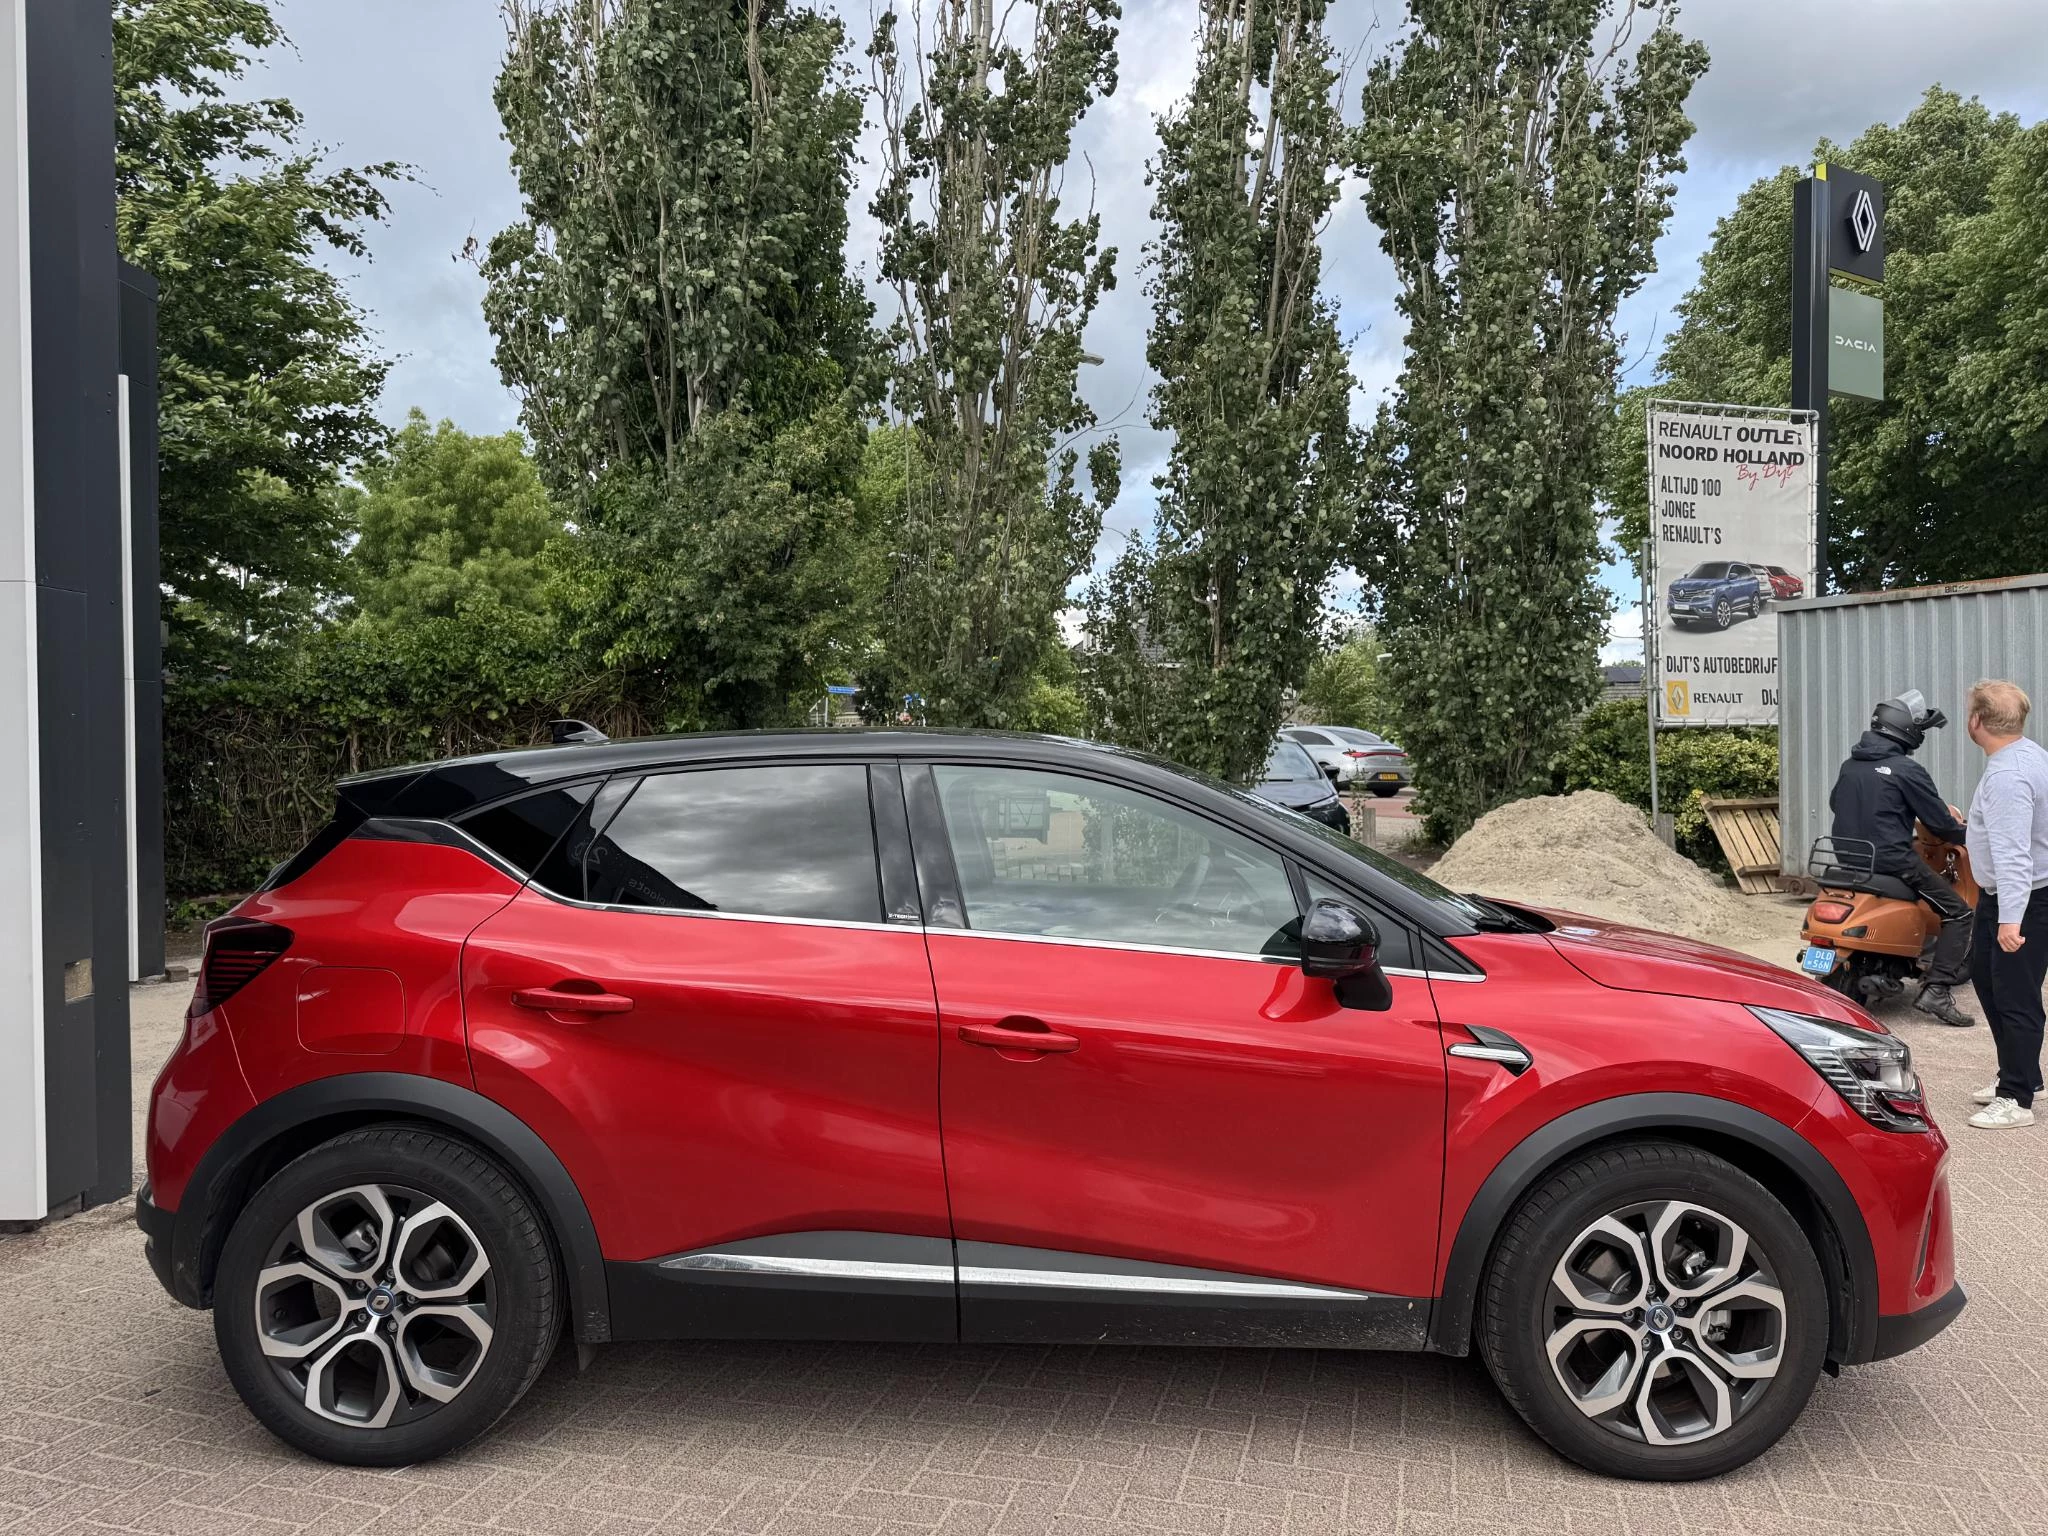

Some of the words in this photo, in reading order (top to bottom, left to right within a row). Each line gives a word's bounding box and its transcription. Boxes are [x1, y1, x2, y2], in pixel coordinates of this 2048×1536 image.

[1834, 335, 1877, 353] DACIA
[1659, 421, 1733, 441] RENAULT
[1659, 443, 1718, 462] NOORD
[1723, 448, 1805, 466] HOLLAND
[1661, 475, 1698, 495] ALTIJD
[1702, 478, 1722, 497] 100
[1736, 463, 1760, 491] By
[1661, 499, 1696, 519] JONGE
[1662, 523, 1722, 545] RENAULT'S
[1666, 655, 1700, 673] DIJT'S
[1703, 656, 1778, 674] AUTOBEDRIJF
[1693, 692, 1743, 704] RENAULT
